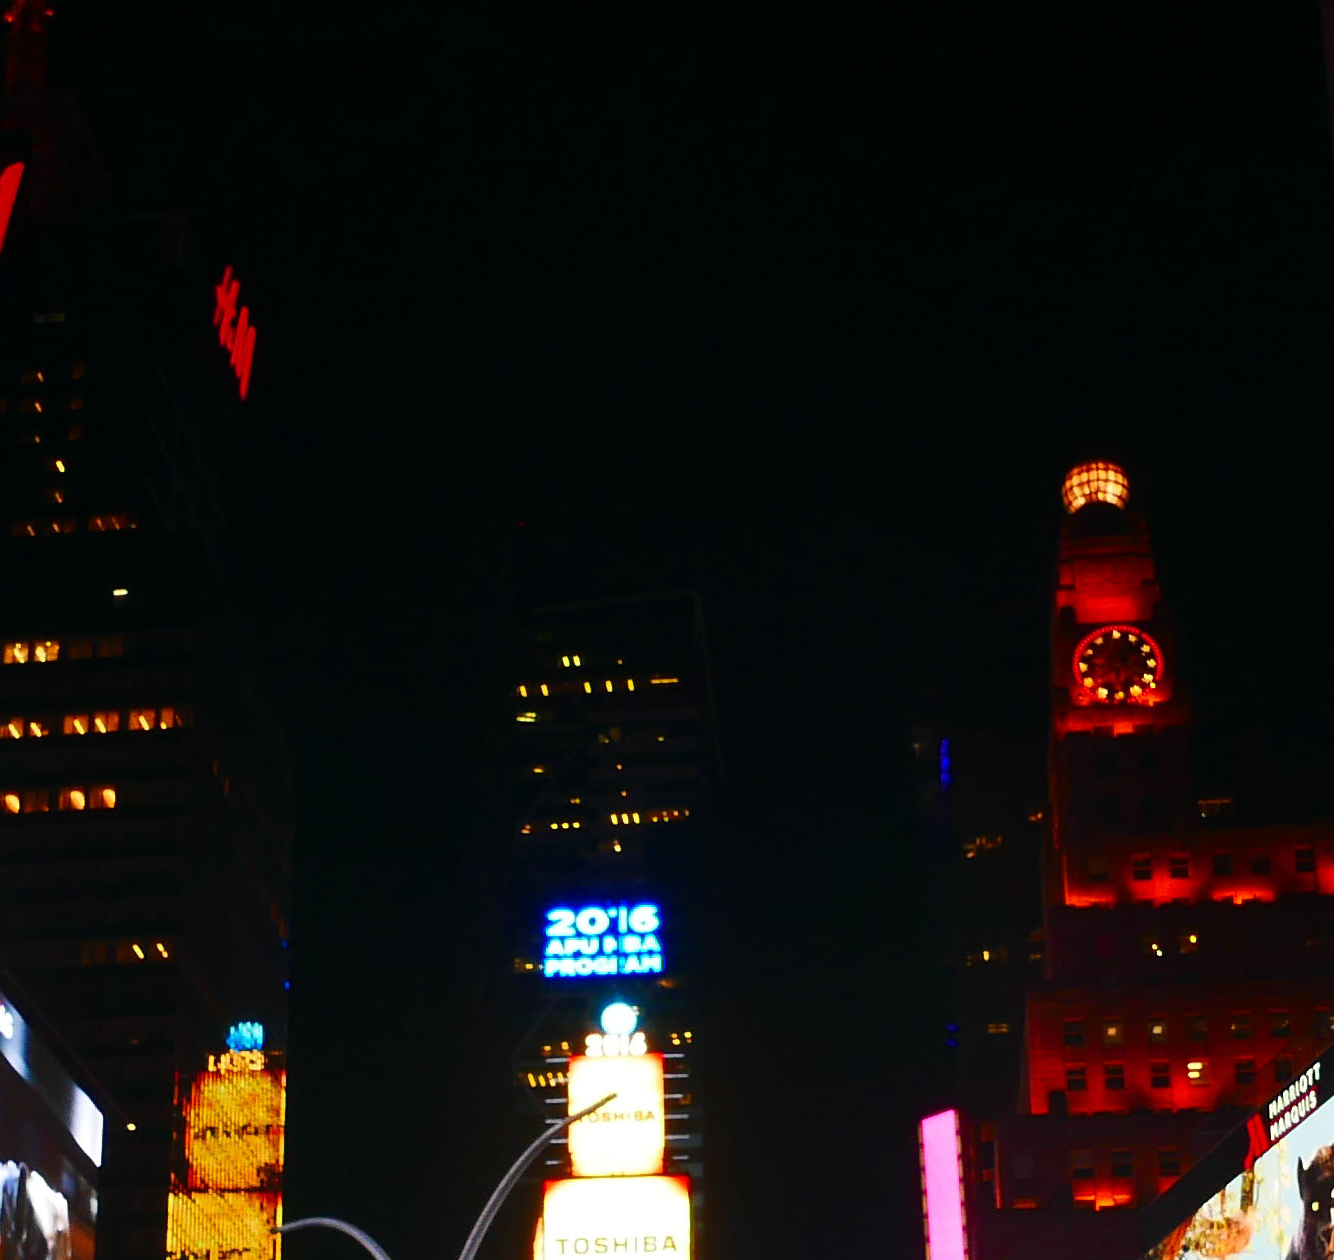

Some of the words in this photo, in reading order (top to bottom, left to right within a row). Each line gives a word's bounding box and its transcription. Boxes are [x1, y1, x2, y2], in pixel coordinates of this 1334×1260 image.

[584, 1031, 648, 1058] 2016
[1268, 1061, 1321, 1119] MARRIOTT
[576, 1109, 656, 1123] TOSHIBA
[1269, 1089, 1317, 1141] MARQUIS
[557, 1236, 679, 1256] TOSHIBA
